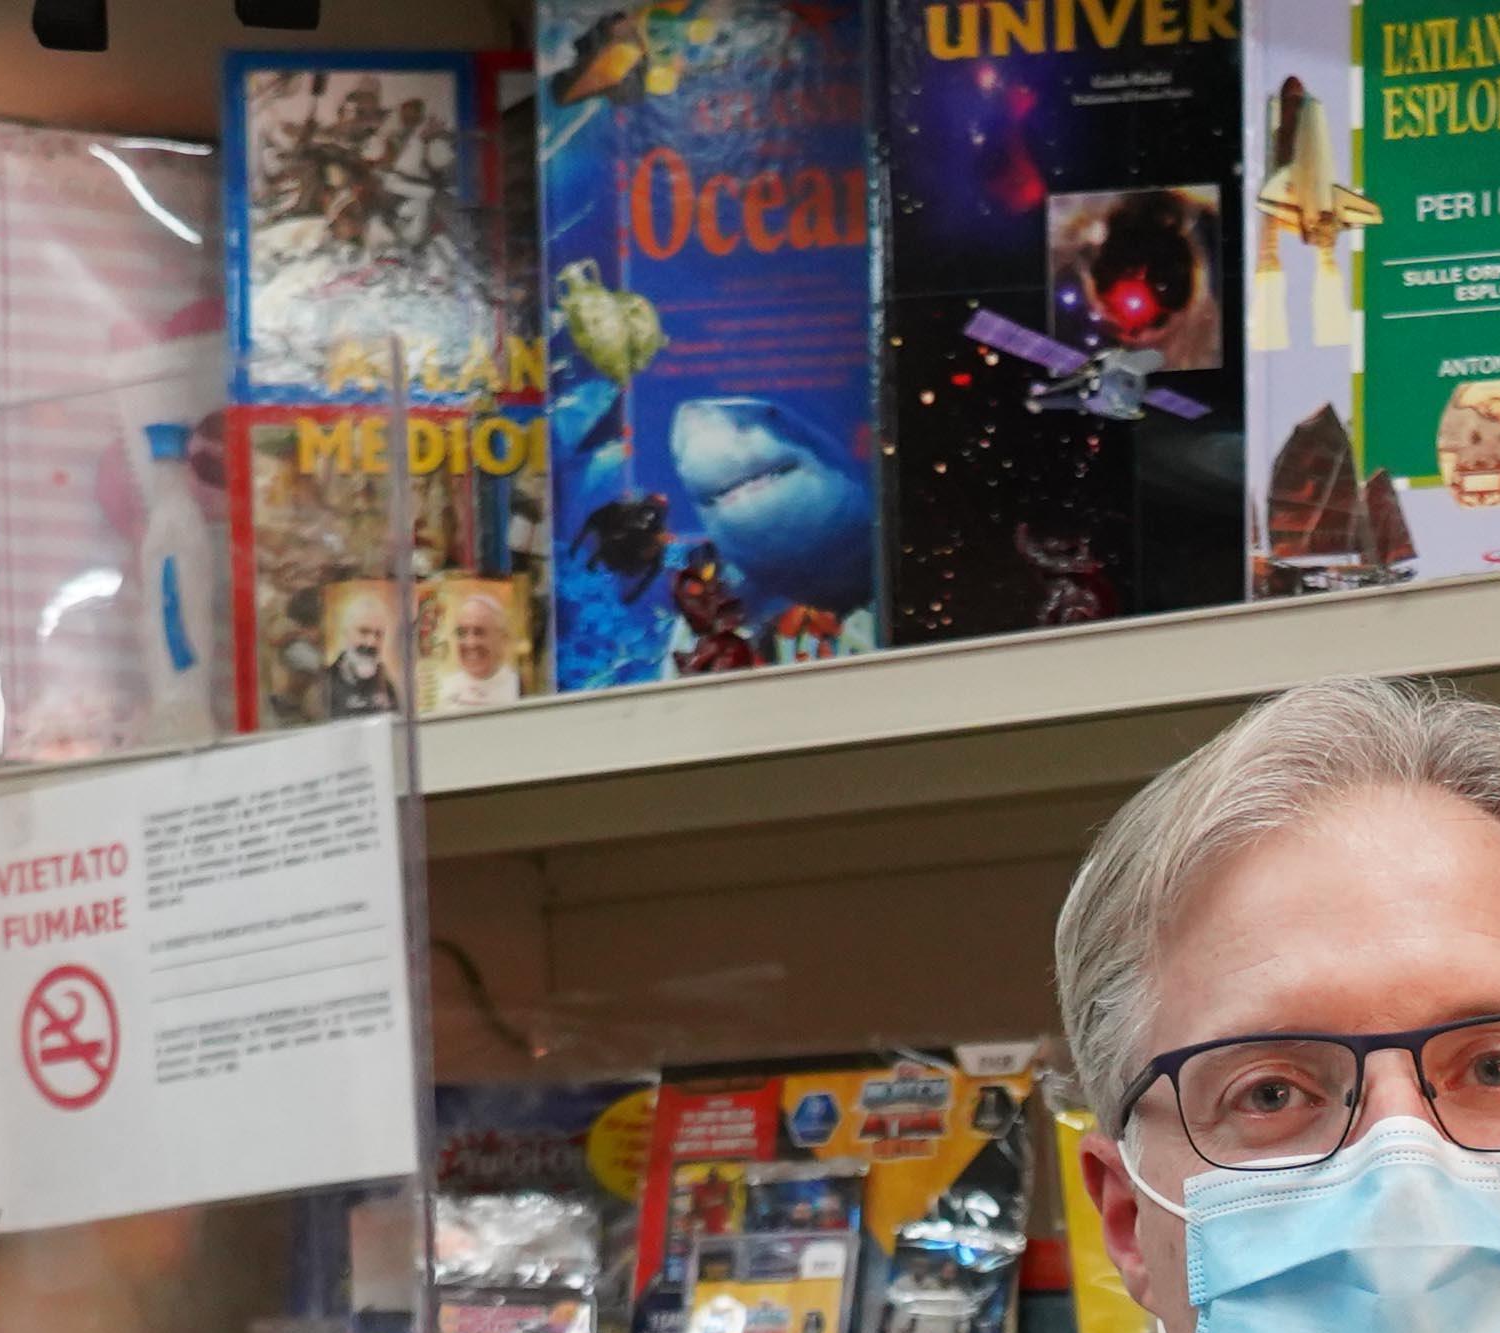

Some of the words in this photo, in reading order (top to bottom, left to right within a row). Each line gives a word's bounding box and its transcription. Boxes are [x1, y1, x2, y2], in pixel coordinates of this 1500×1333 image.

[1417, 191, 1475, 222] PER
[1403, 266, 1462, 288] SULLE
[2, 898, 127, 950] FUMARE
